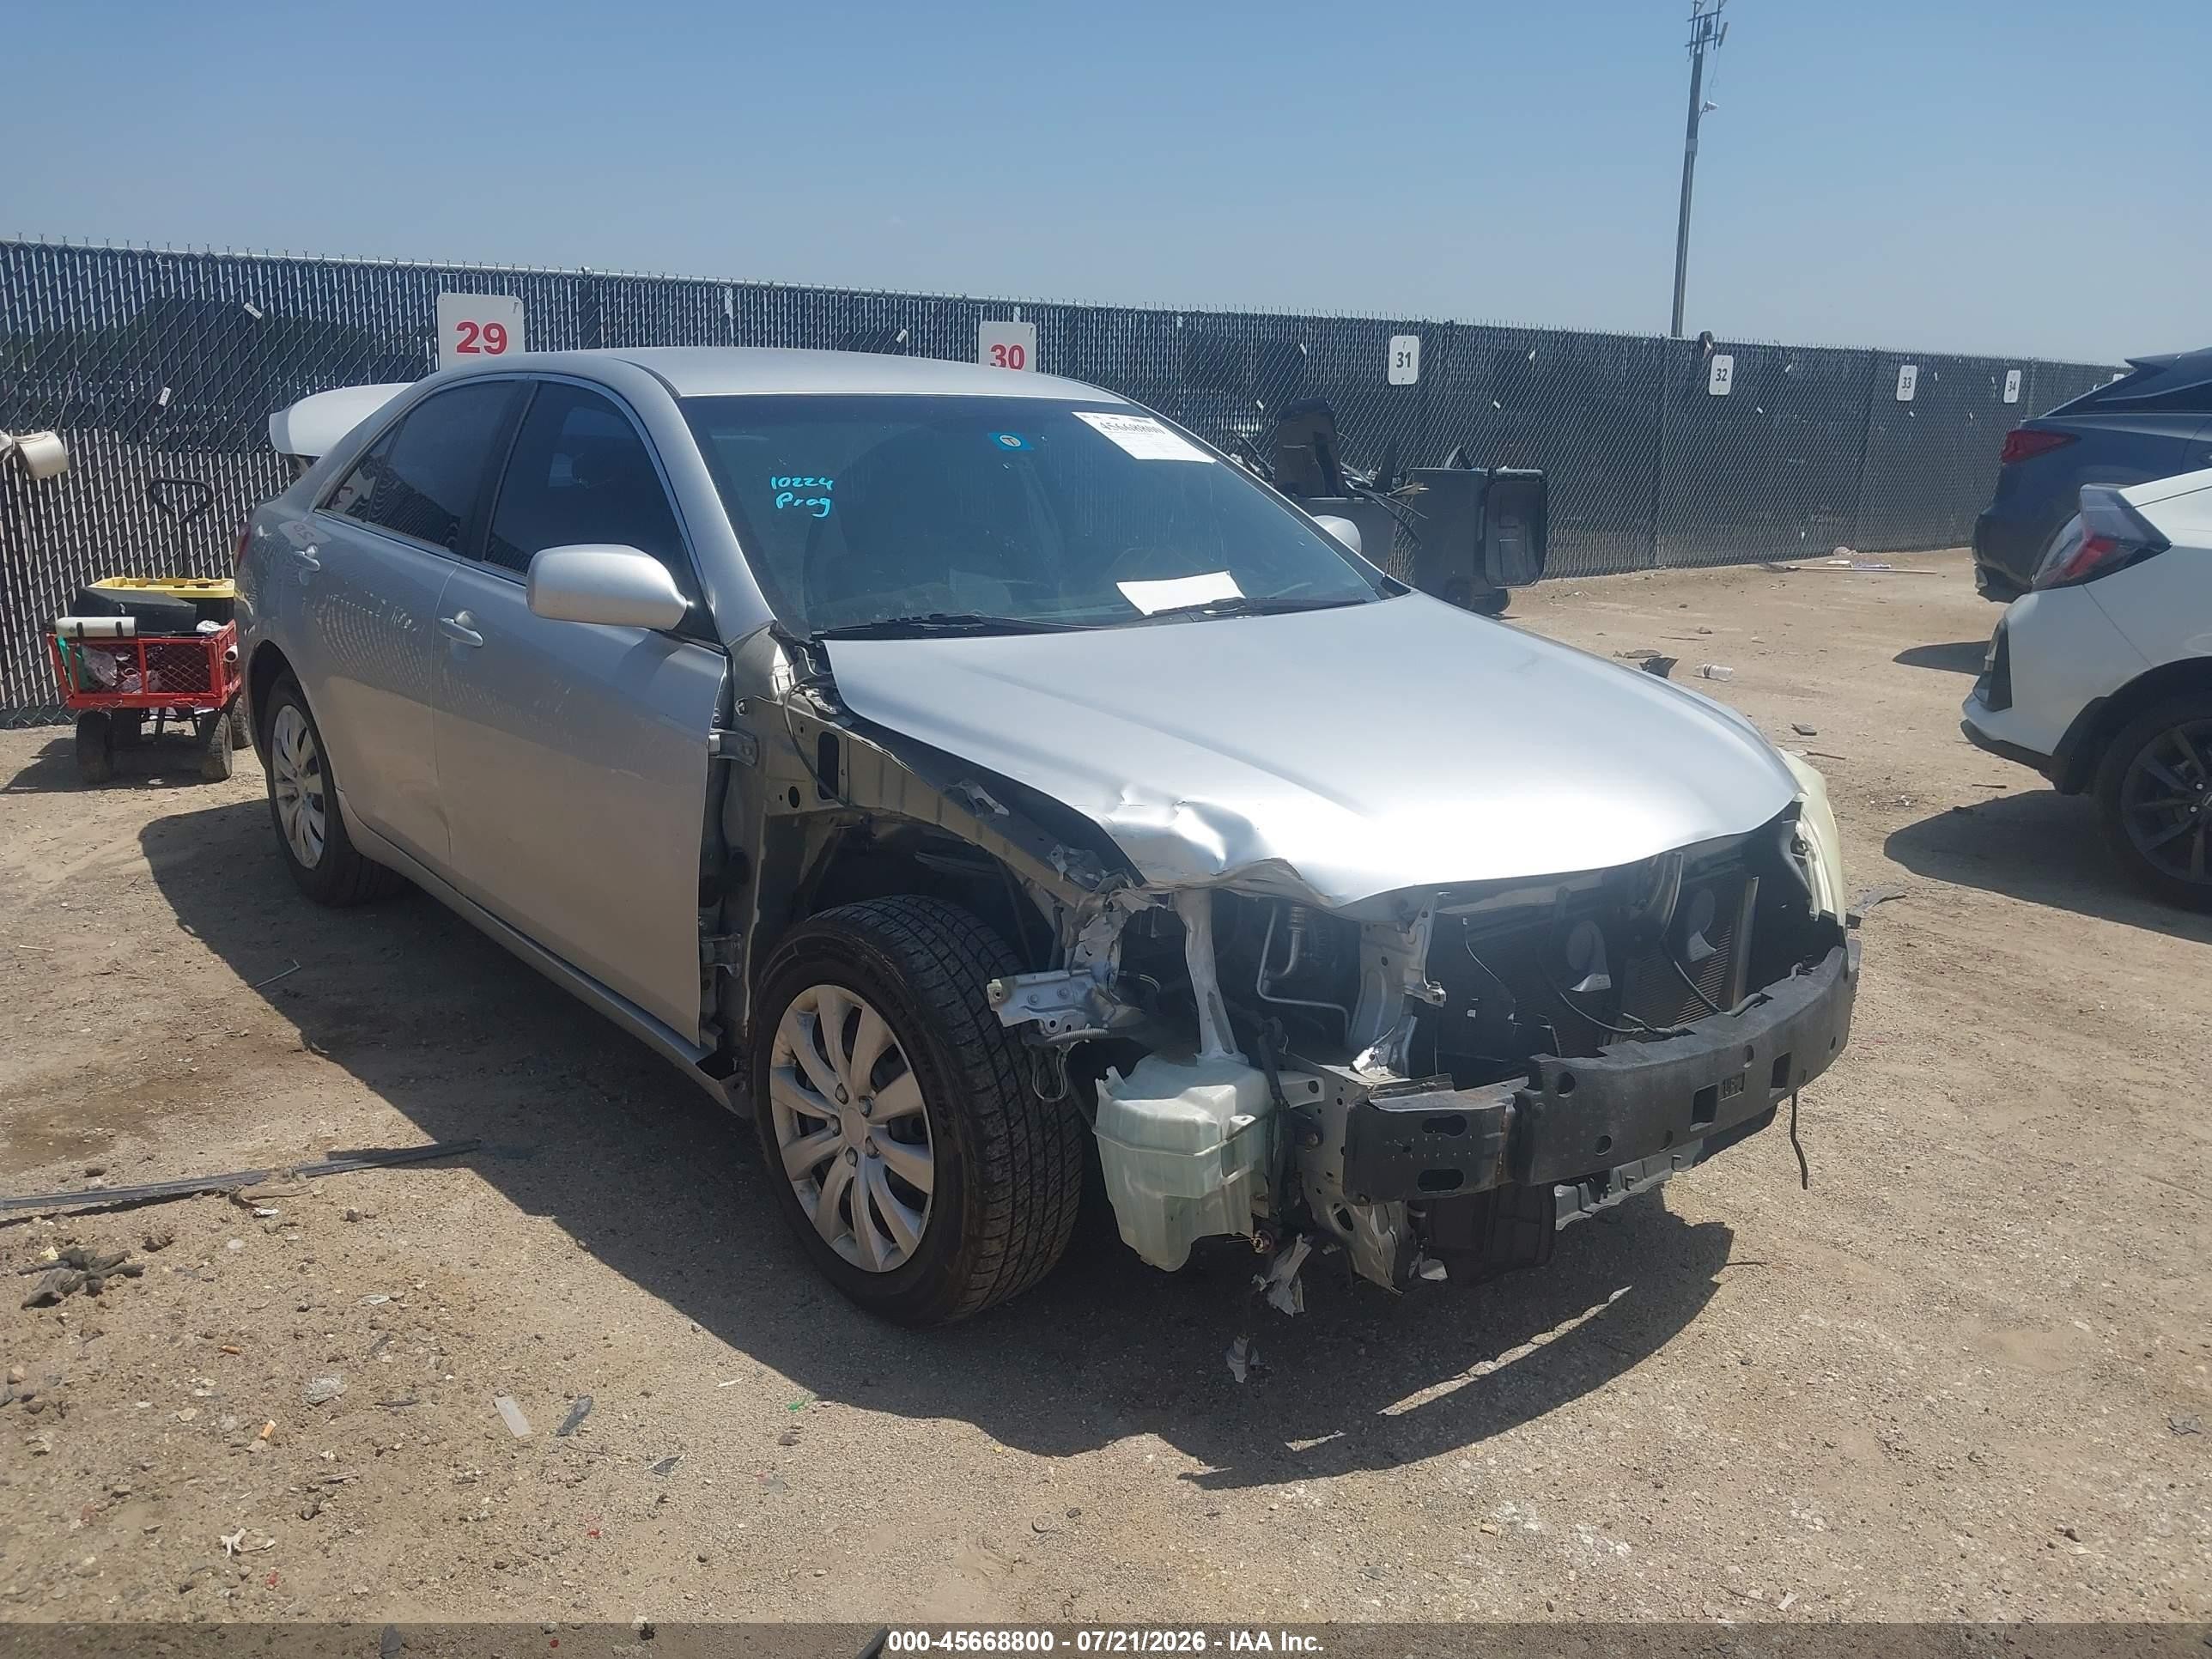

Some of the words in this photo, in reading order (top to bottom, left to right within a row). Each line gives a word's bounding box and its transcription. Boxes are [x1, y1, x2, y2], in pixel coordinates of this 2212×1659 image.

[456, 321, 507, 355] 29
[989, 344, 1025, 370] 30
[1396, 351, 1412, 368] 31
[1715, 368, 1728, 382] 32
[1901, 376, 1912, 389] 33
[2008, 380, 2016, 392] 34
[771, 477, 834, 490] 10224
